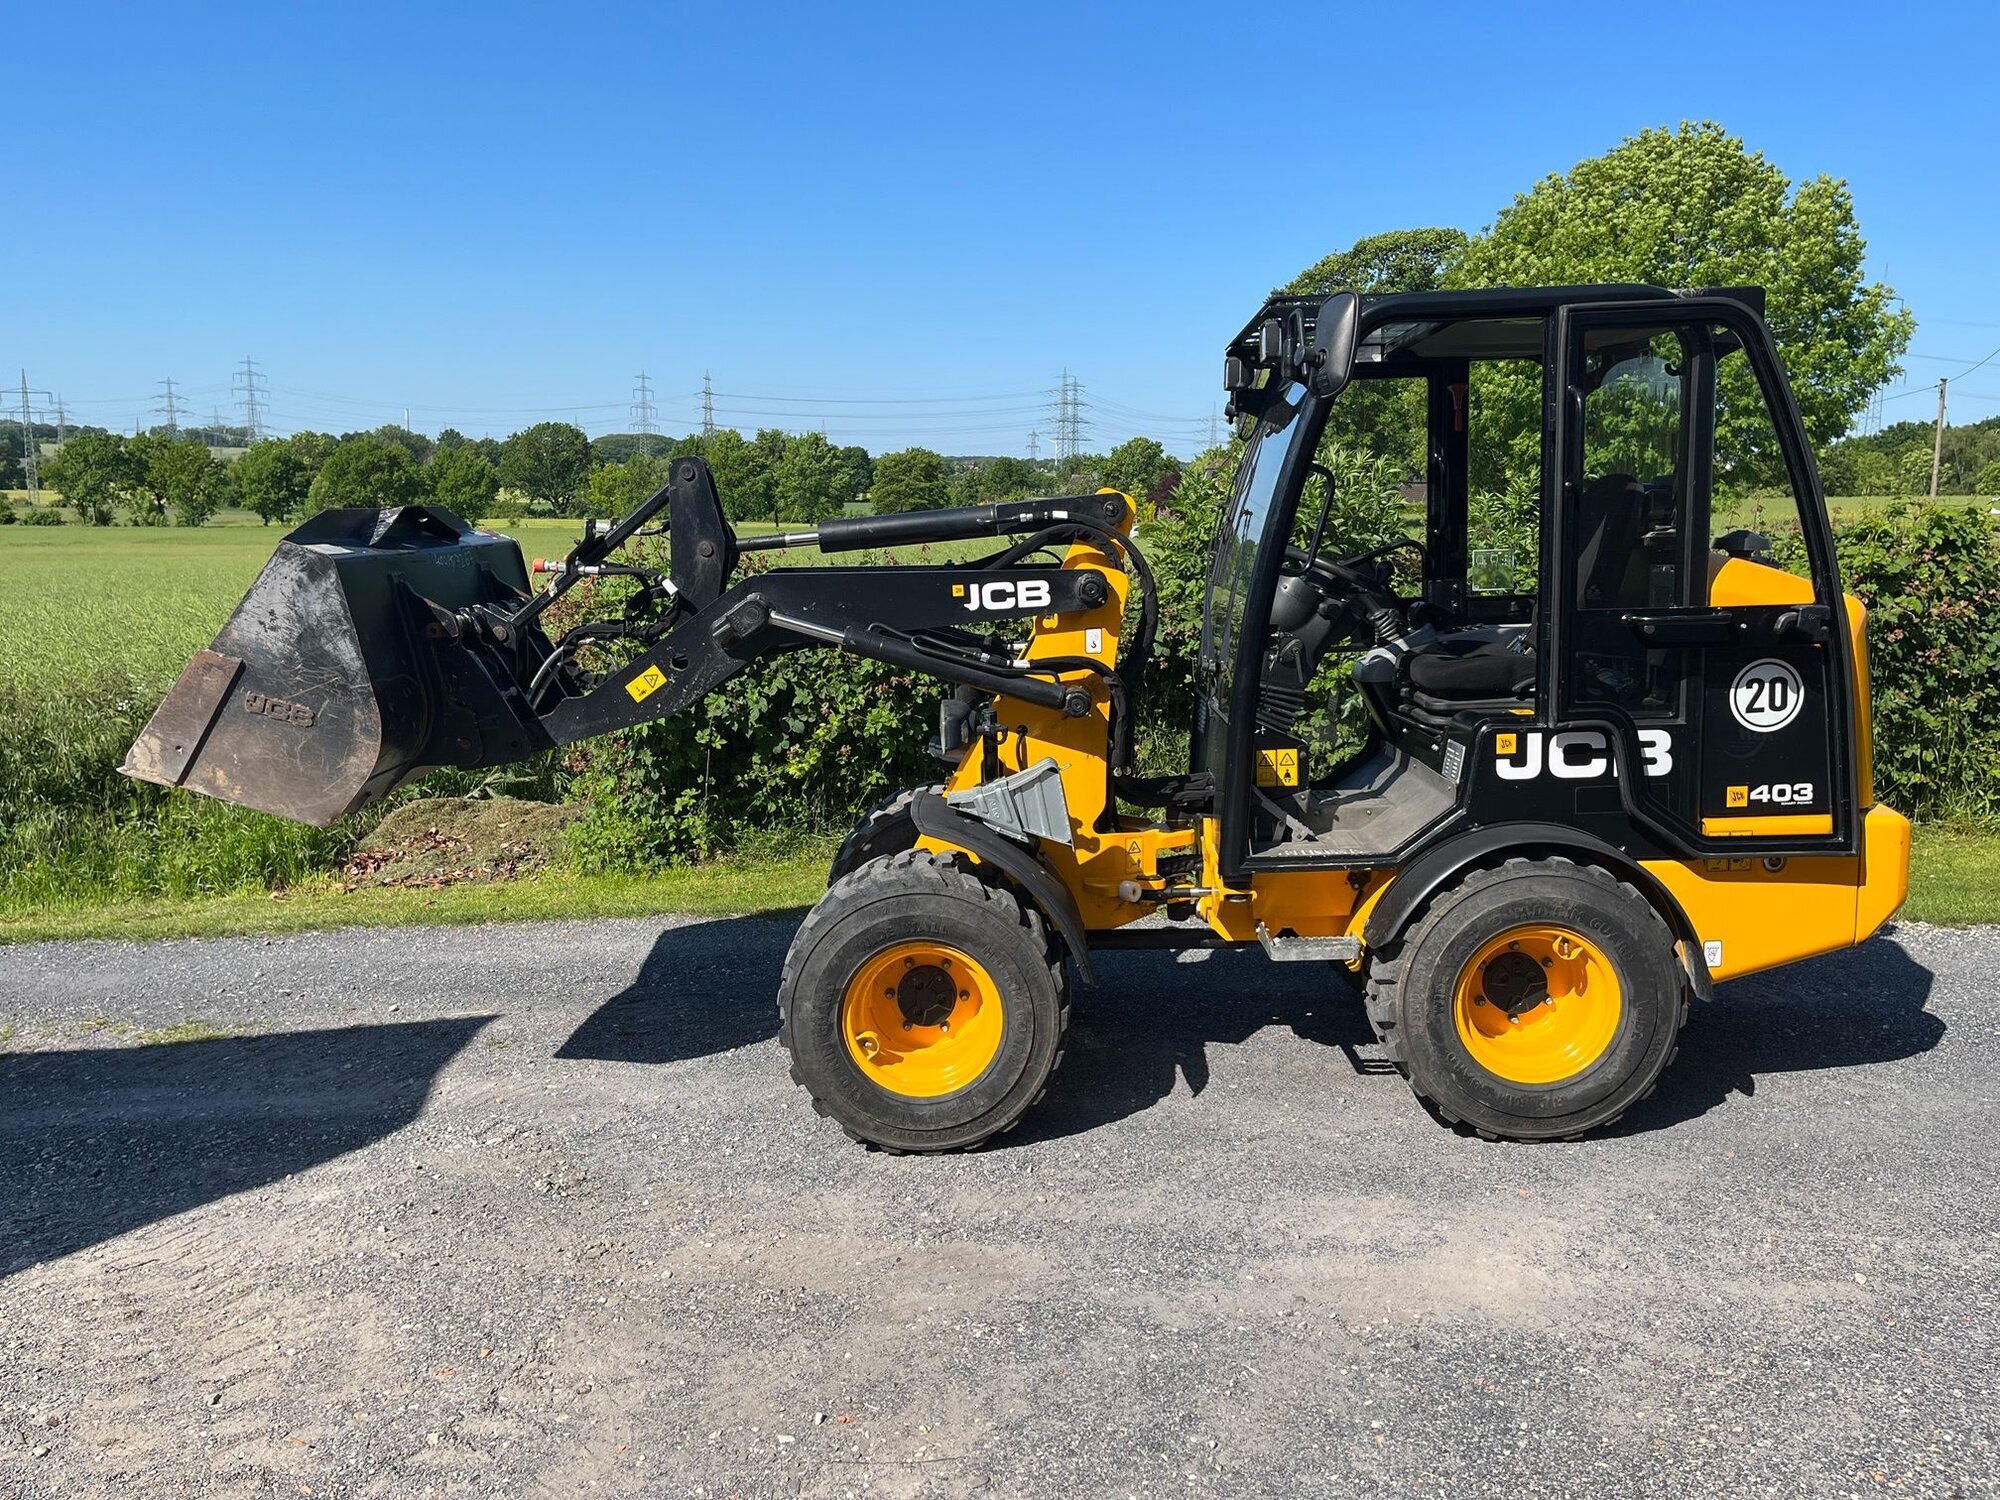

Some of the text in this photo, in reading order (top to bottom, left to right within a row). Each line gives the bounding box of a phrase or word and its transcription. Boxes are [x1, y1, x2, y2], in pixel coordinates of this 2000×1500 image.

[964, 580, 1051, 611] JCB
[245, 691, 315, 728] JCB
[1745, 676, 1788, 713] 20
[1496, 730, 1673, 780] JCB
[1749, 783, 1814, 803] 403
